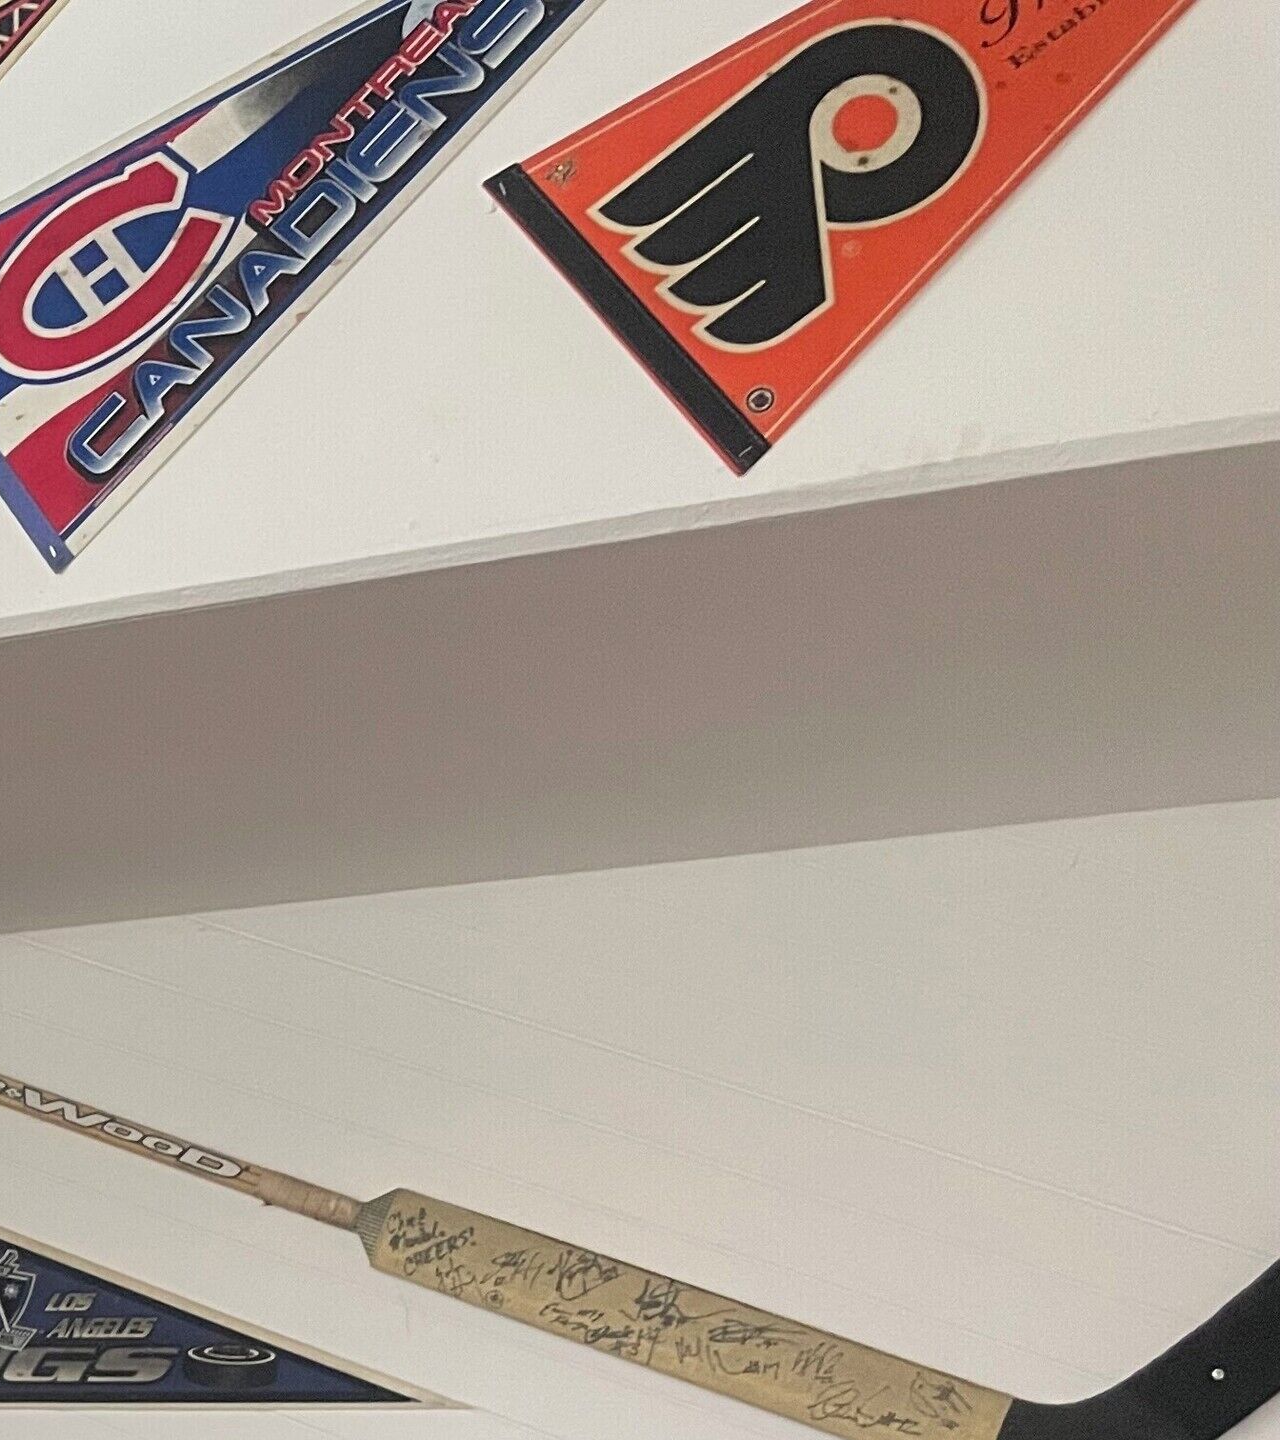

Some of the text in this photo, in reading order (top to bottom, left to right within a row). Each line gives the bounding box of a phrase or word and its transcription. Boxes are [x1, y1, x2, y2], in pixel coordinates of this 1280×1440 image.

[249, 0, 483, 226] MONTREA
[67, 0, 546, 477] CANADIENS
[44, 1292, 97, 1313] LOS
[45, 1315, 158, 1339] ANGELES
